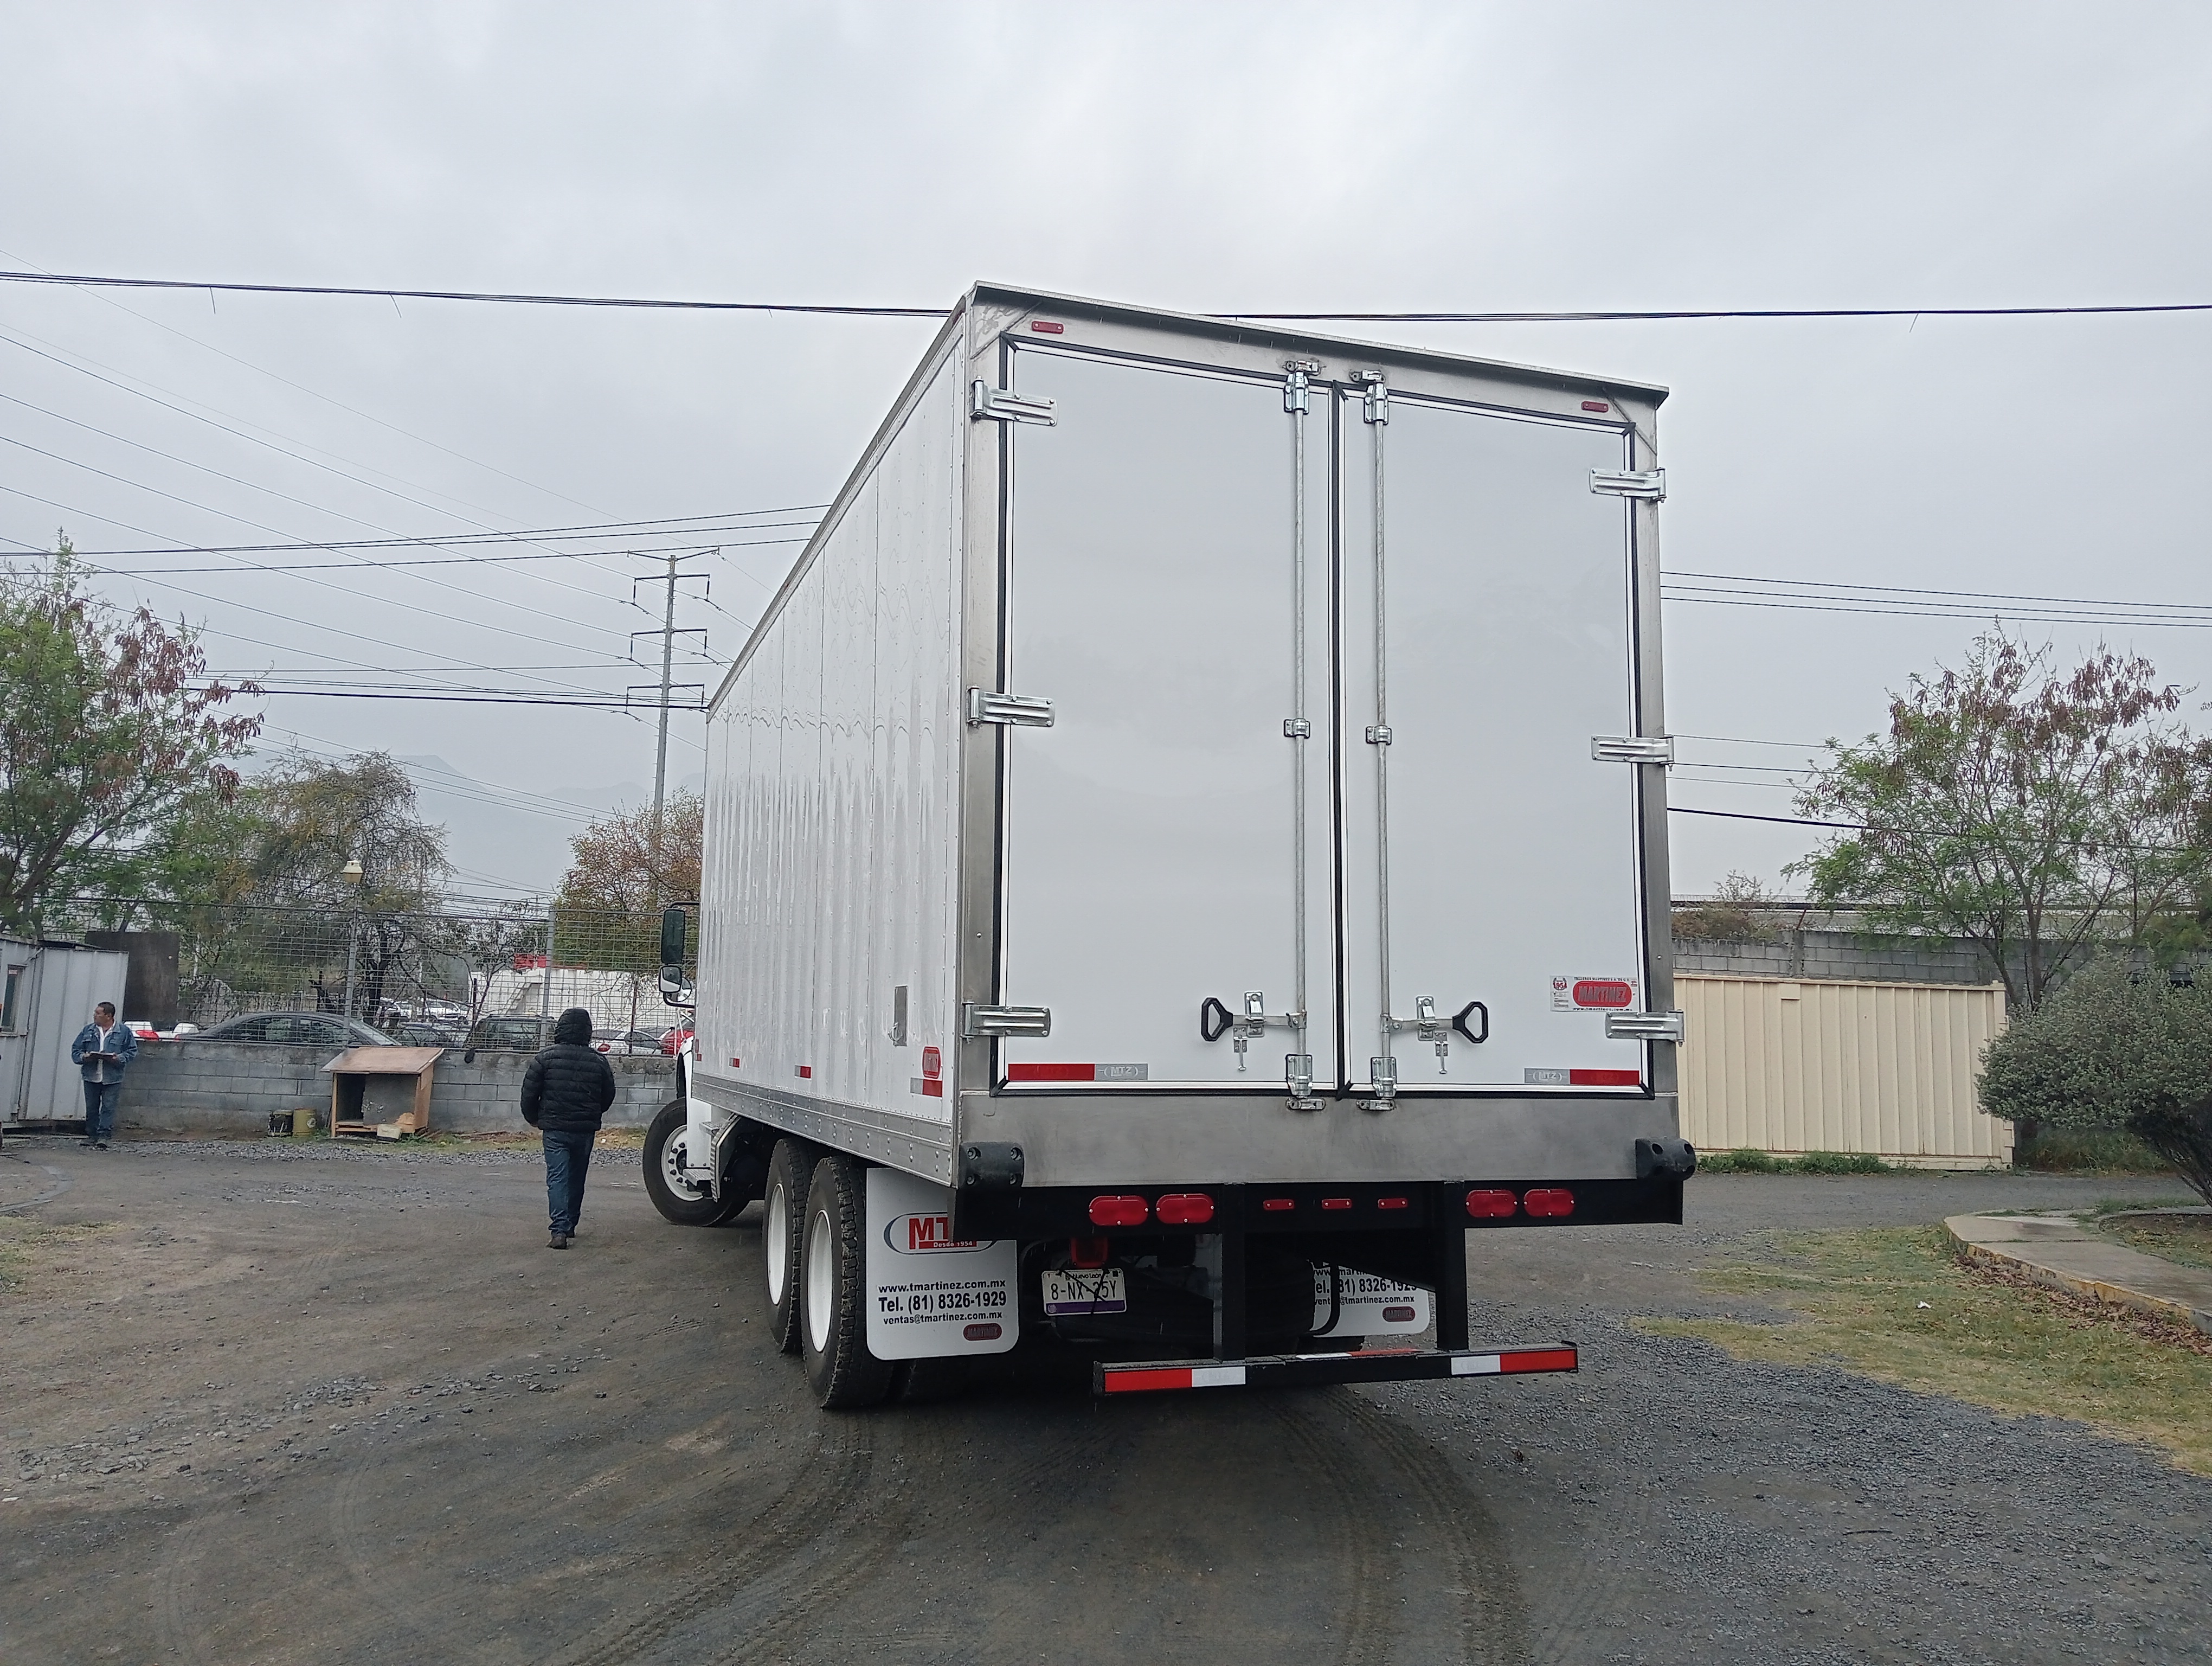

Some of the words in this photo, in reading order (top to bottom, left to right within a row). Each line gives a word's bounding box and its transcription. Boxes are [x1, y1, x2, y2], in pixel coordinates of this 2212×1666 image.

[909, 1217, 948, 1250] MT
[878, 1280, 1006, 1293] www.tmartinez.com.mx
[1316, 1280, 1330, 1293] el.
[1339, 1278, 1355, 1296] 81)
[878, 1297, 903, 1312] Tel.
[908, 1295, 934, 1314] (81)
[938, 1291, 1006, 1309] 8326-1929
[1315, 1296, 1414, 1305] vent@tmartinez.com.mx
[884, 1312, 1002, 1324] ventas@tmartinez.com.mx
